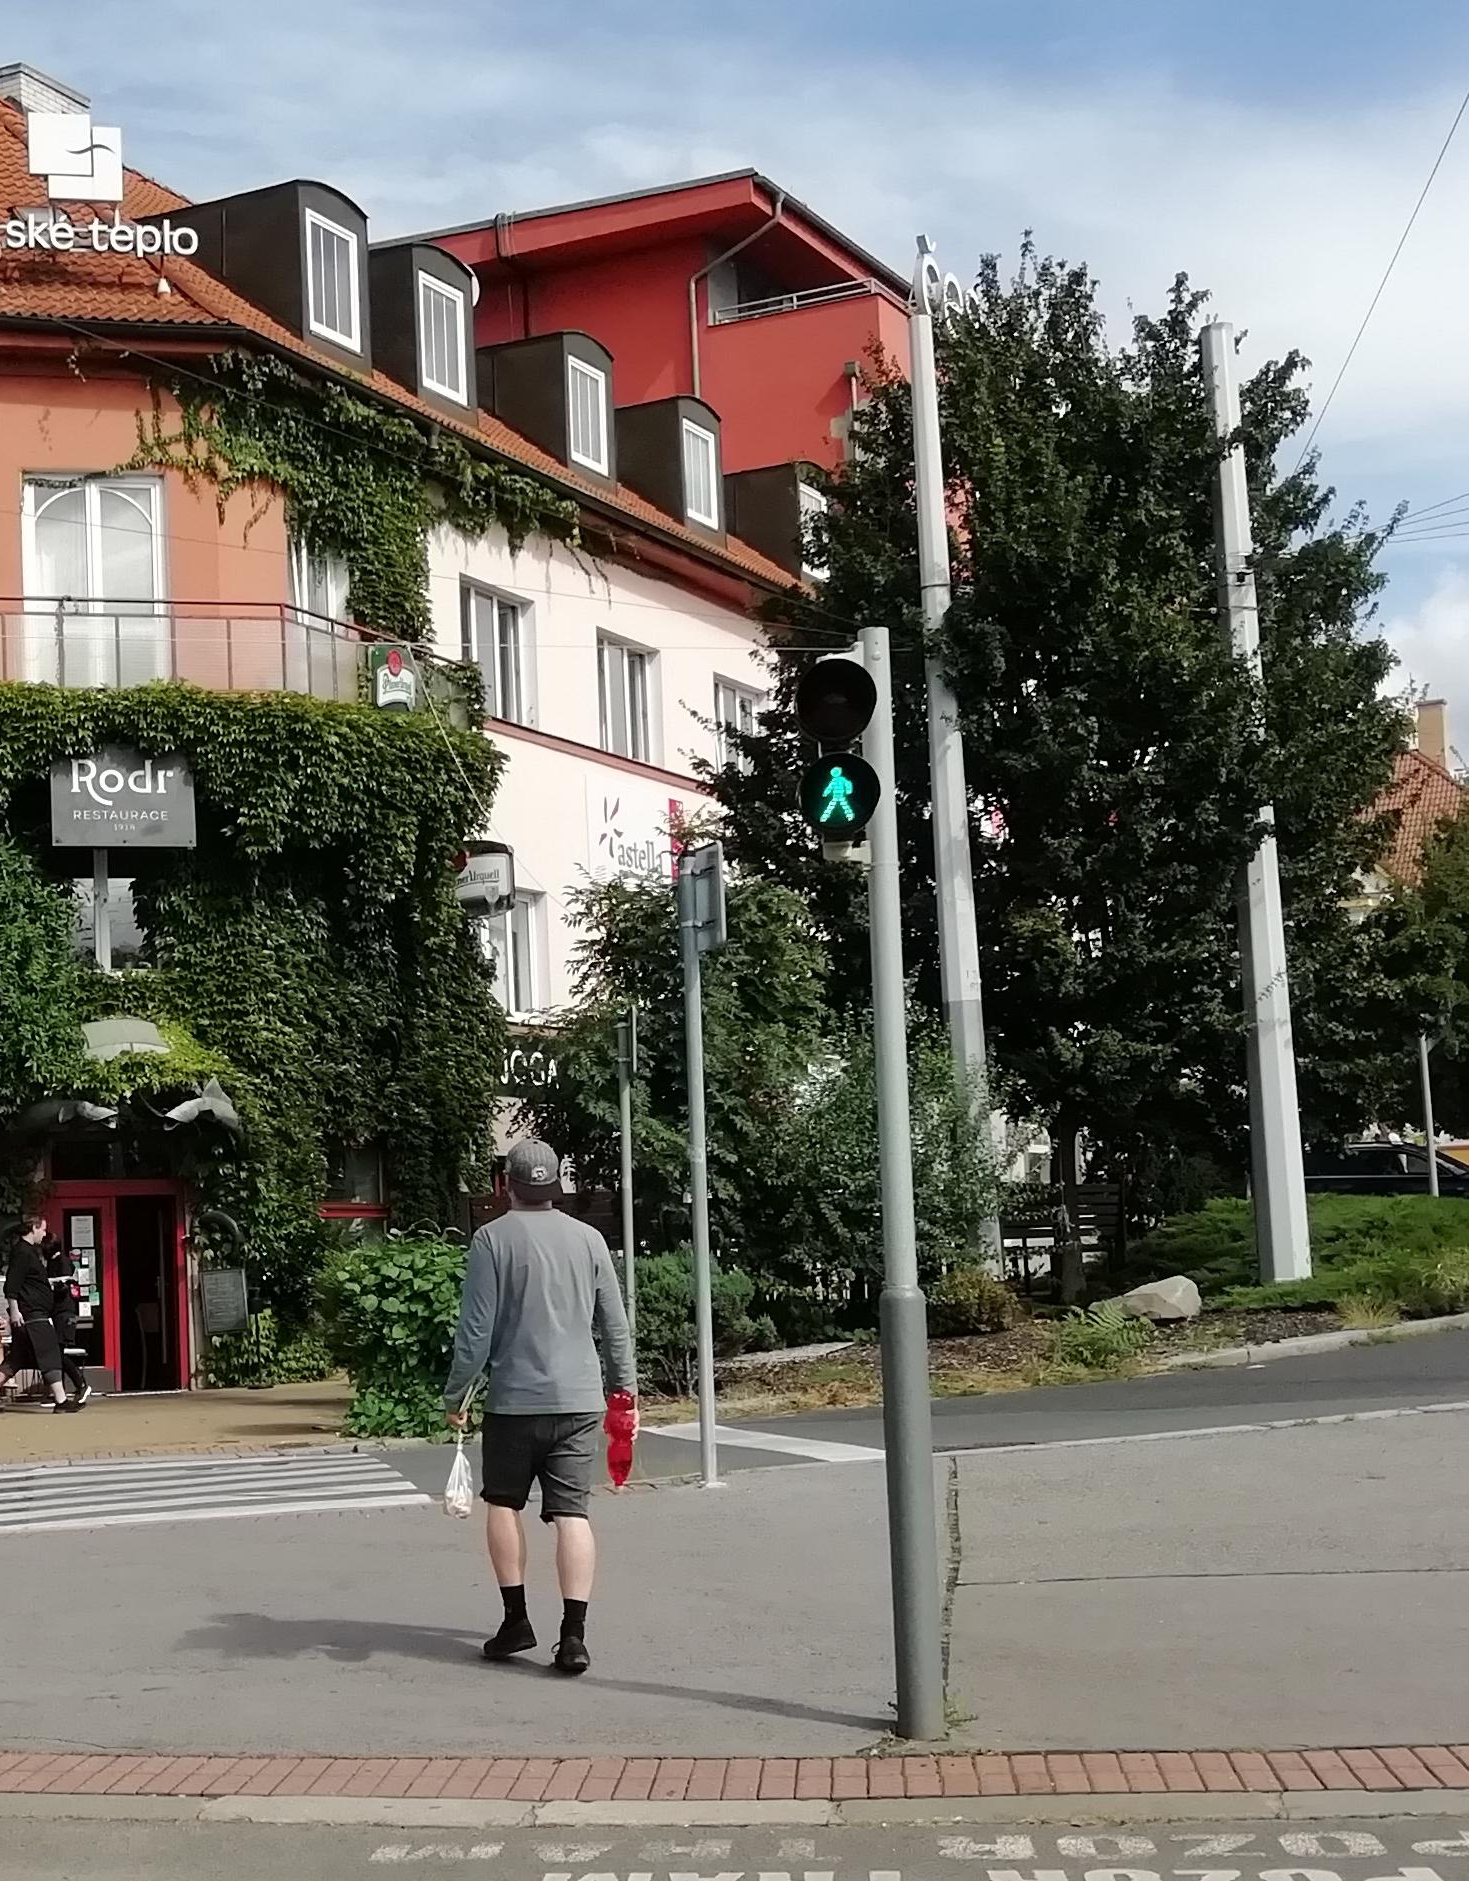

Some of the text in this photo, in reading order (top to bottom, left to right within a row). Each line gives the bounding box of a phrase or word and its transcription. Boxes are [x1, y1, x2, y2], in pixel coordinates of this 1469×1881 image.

[6, 213, 199, 258] ské teplo
[71, 758, 174, 806] Rodr
[73, 810, 169, 821] RESTAURACE
